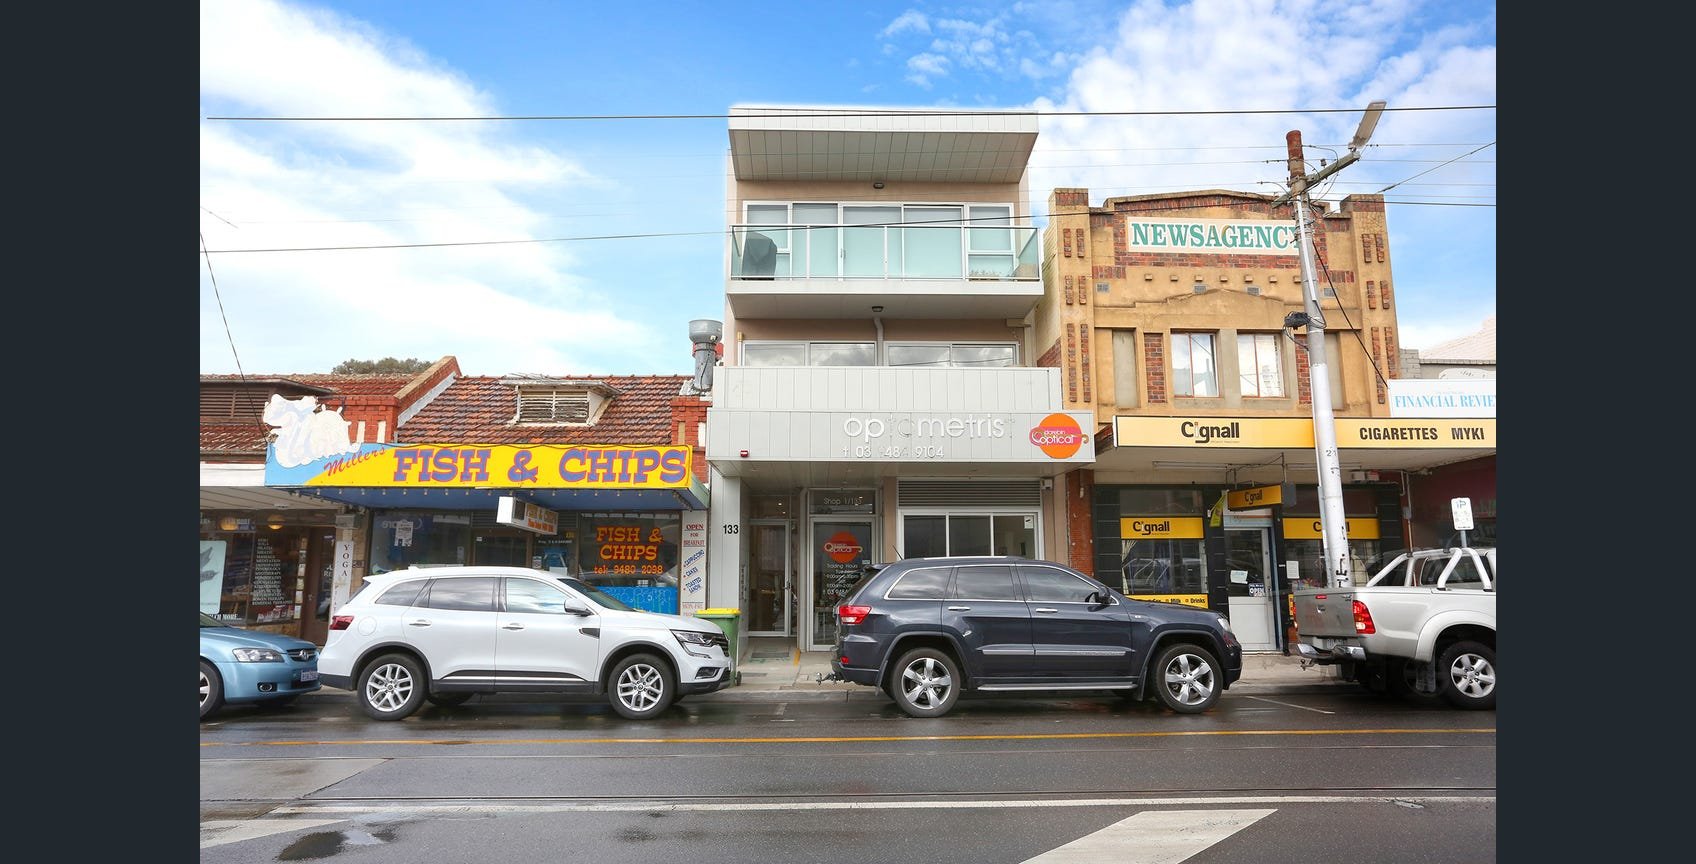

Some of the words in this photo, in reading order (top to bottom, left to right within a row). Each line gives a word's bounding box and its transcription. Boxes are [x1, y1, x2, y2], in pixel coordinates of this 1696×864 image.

[1395, 395, 1457, 408] FINANCIAL
[1460, 394, 1496, 408] REVIE
[1181, 421, 1240, 443] Cignall
[1359, 427, 1438, 440] CIGARETTES
[1451, 427, 1485, 440] MYKI
[855, 446, 872, 459] 03
[915, 446, 945, 459] 9104
[393, 448, 492, 483] FISH
[507, 449, 539, 484] &
[558, 448, 688, 485] CHIPS
[823, 497, 841, 505] Shop
[596, 527, 641, 542] FISH
[648, 527, 664, 543] &
[723, 524, 739, 535] 133
[1132, 521, 1170, 536] Cignall
[600, 544, 658, 561] CHIPS
[341, 544, 350, 577] YOGA
[613, 565, 637, 574] 9480
